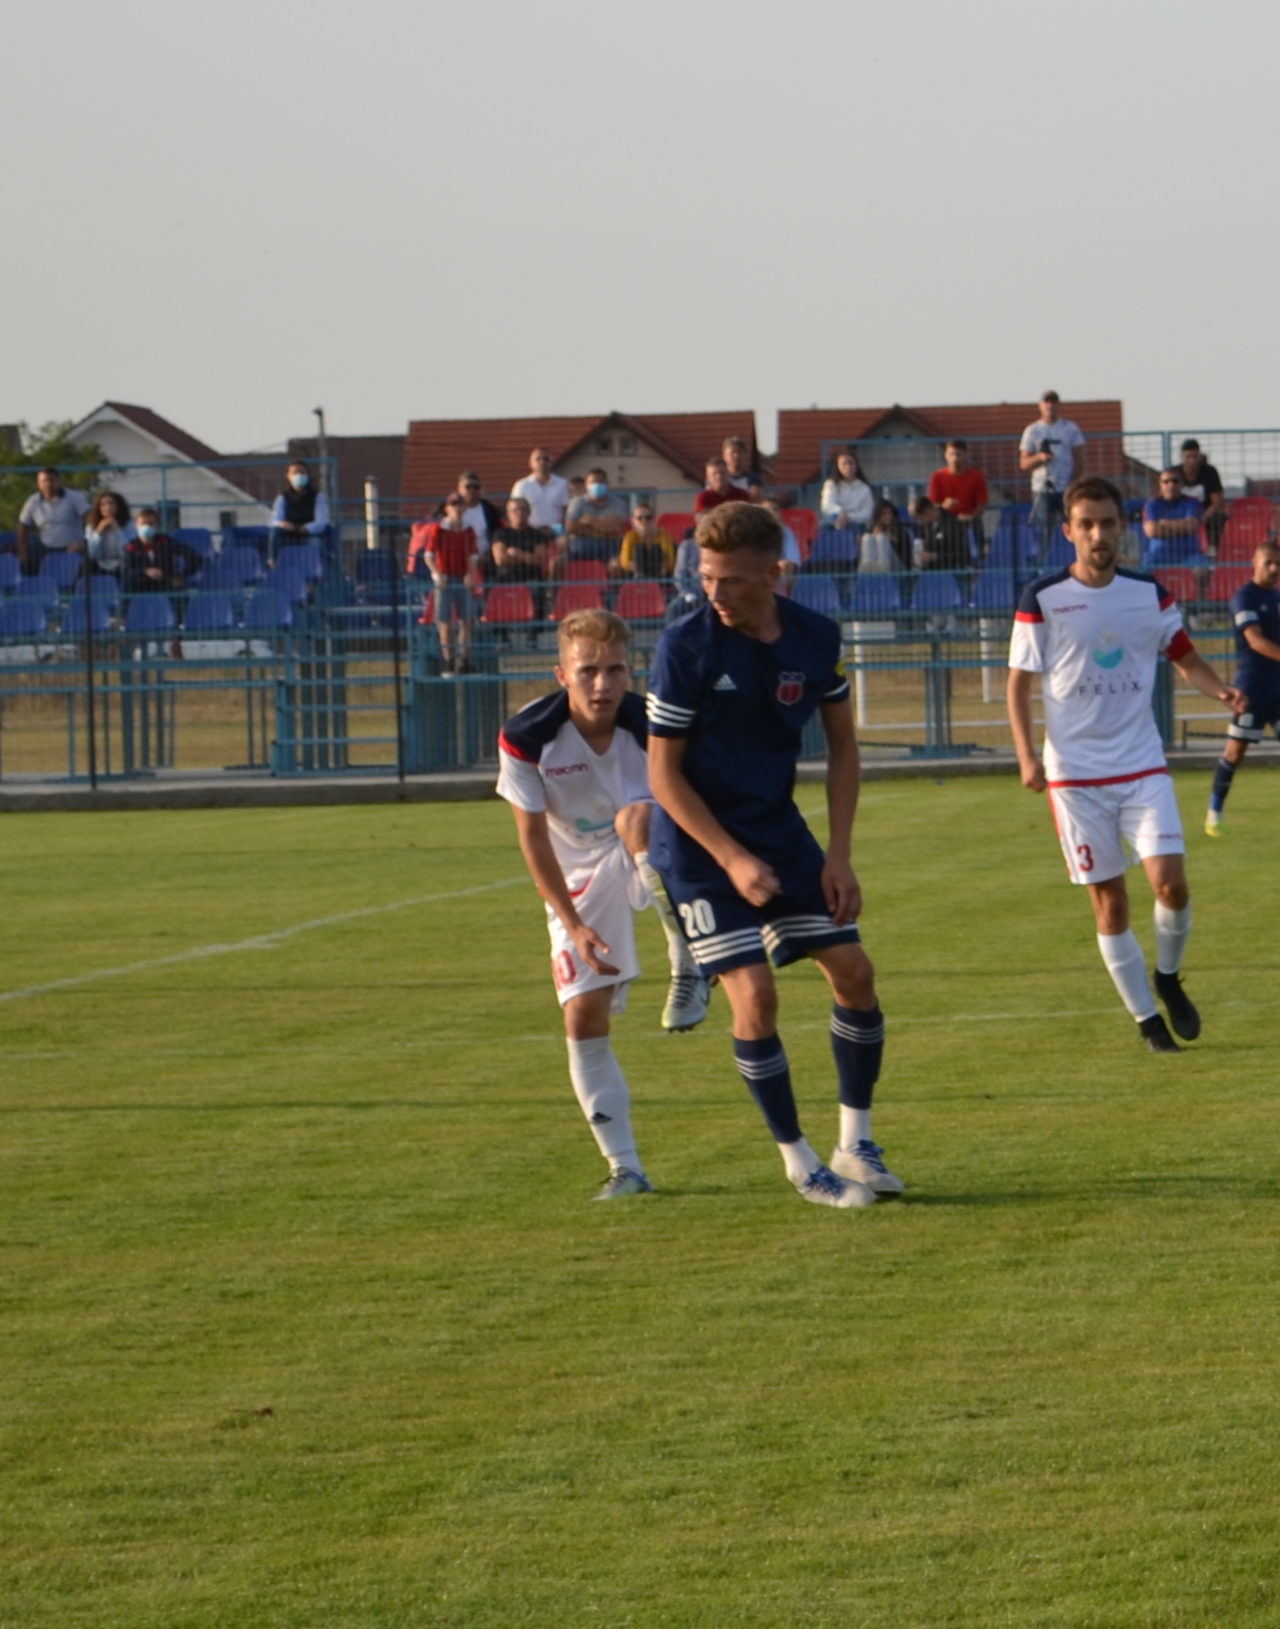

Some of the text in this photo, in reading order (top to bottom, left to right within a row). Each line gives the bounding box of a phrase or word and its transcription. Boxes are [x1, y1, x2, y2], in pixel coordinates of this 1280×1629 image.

[1078, 681, 1142, 696] FELIX
[1077, 843, 1094, 872] 3
[677, 898, 717, 939] 20
